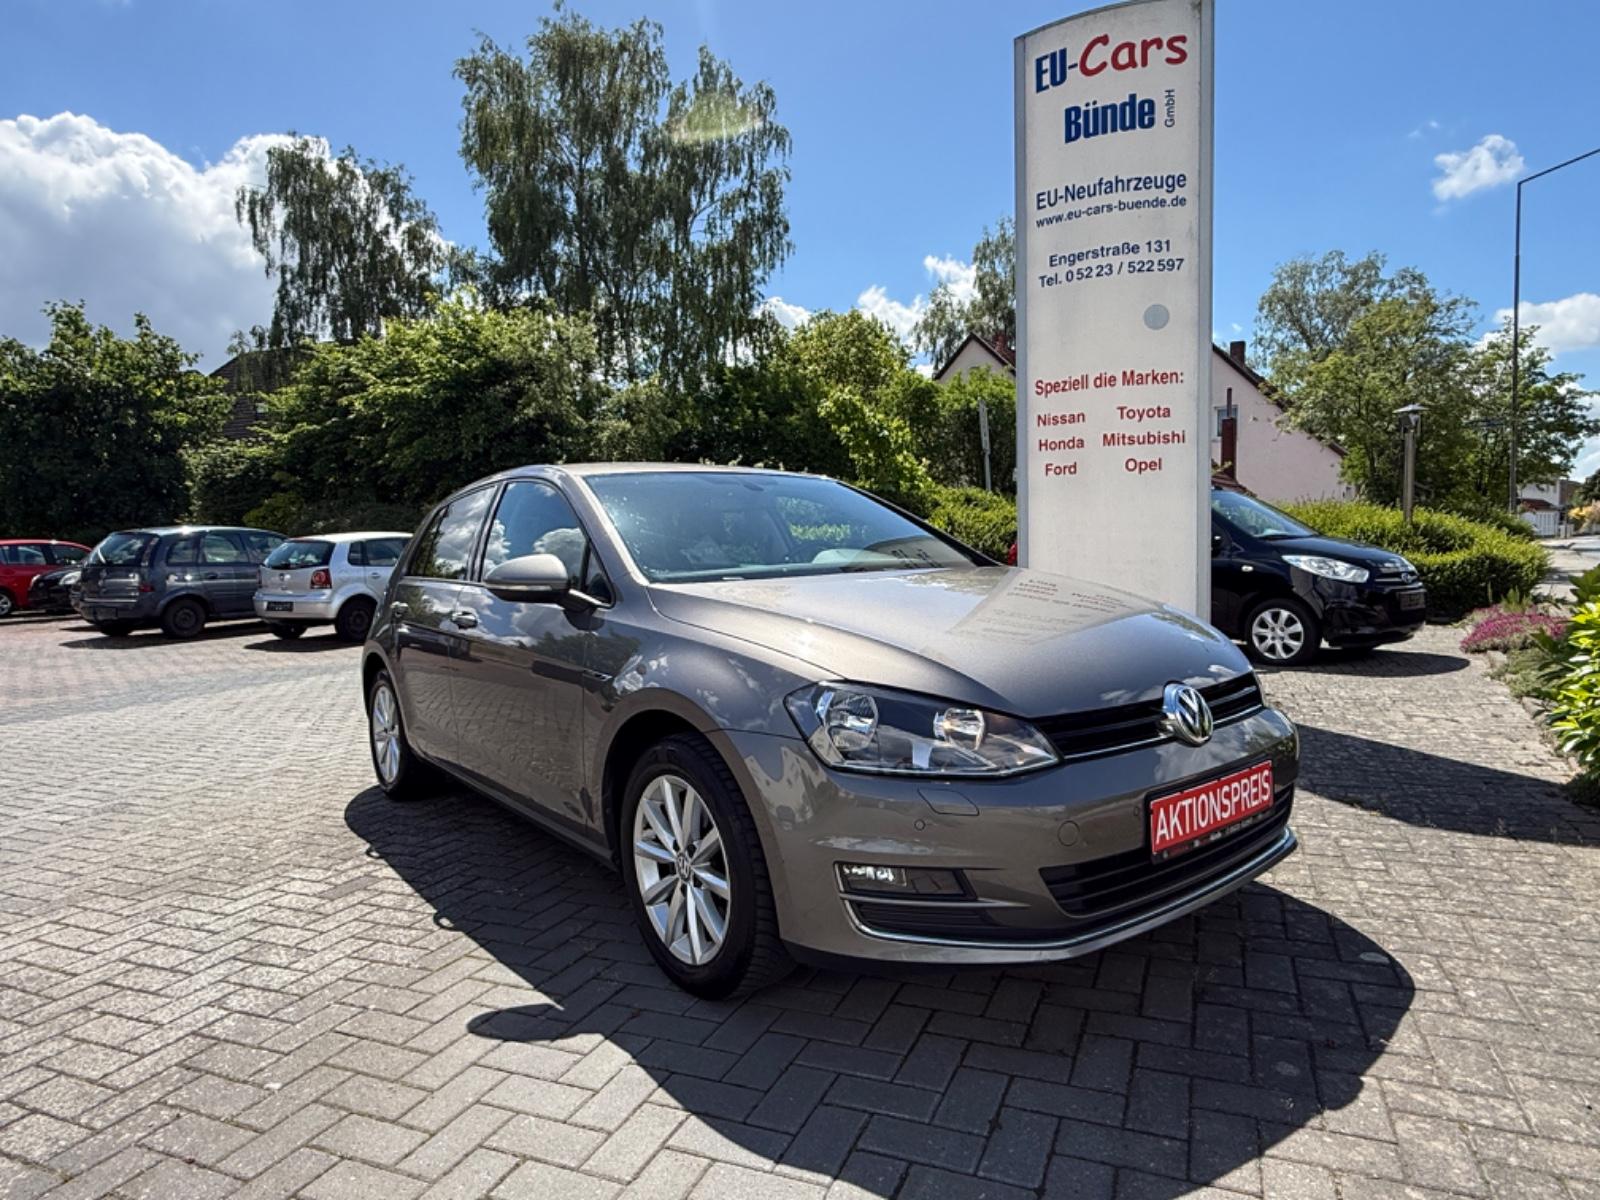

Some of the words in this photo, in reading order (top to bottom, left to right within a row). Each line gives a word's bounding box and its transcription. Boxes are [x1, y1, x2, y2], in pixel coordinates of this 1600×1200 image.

[1035, 34, 1188, 93] EU-Cars
[1064, 93, 1156, 144] Bünde
[1164, 89, 1175, 128] GmbH
[1036, 173, 1187, 210] EU-Neufahrzeuge
[1036, 195, 1187, 228] www.eu-cars-buende.de
[1049, 242, 1140, 267] Engerstraße
[1145, 239, 1171, 253] 131
[1038, 272, 1062, 288] Tel.
[1035, 374, 1089, 398] Speziell
[1093, 372, 1117, 389] die
[1121, 369, 1184, 387] Marken:
[1037, 412, 1086, 427] Nissan
[1117, 405, 1171, 422] Toyota
[1038, 436, 1085, 451] Honda
[1102, 430, 1185, 447] Mitsubishi
[1045, 462, 1077, 476] Ford
[1125, 457, 1162, 474] Opel
[1155, 769, 1270, 845] AKTIONSPREIS
